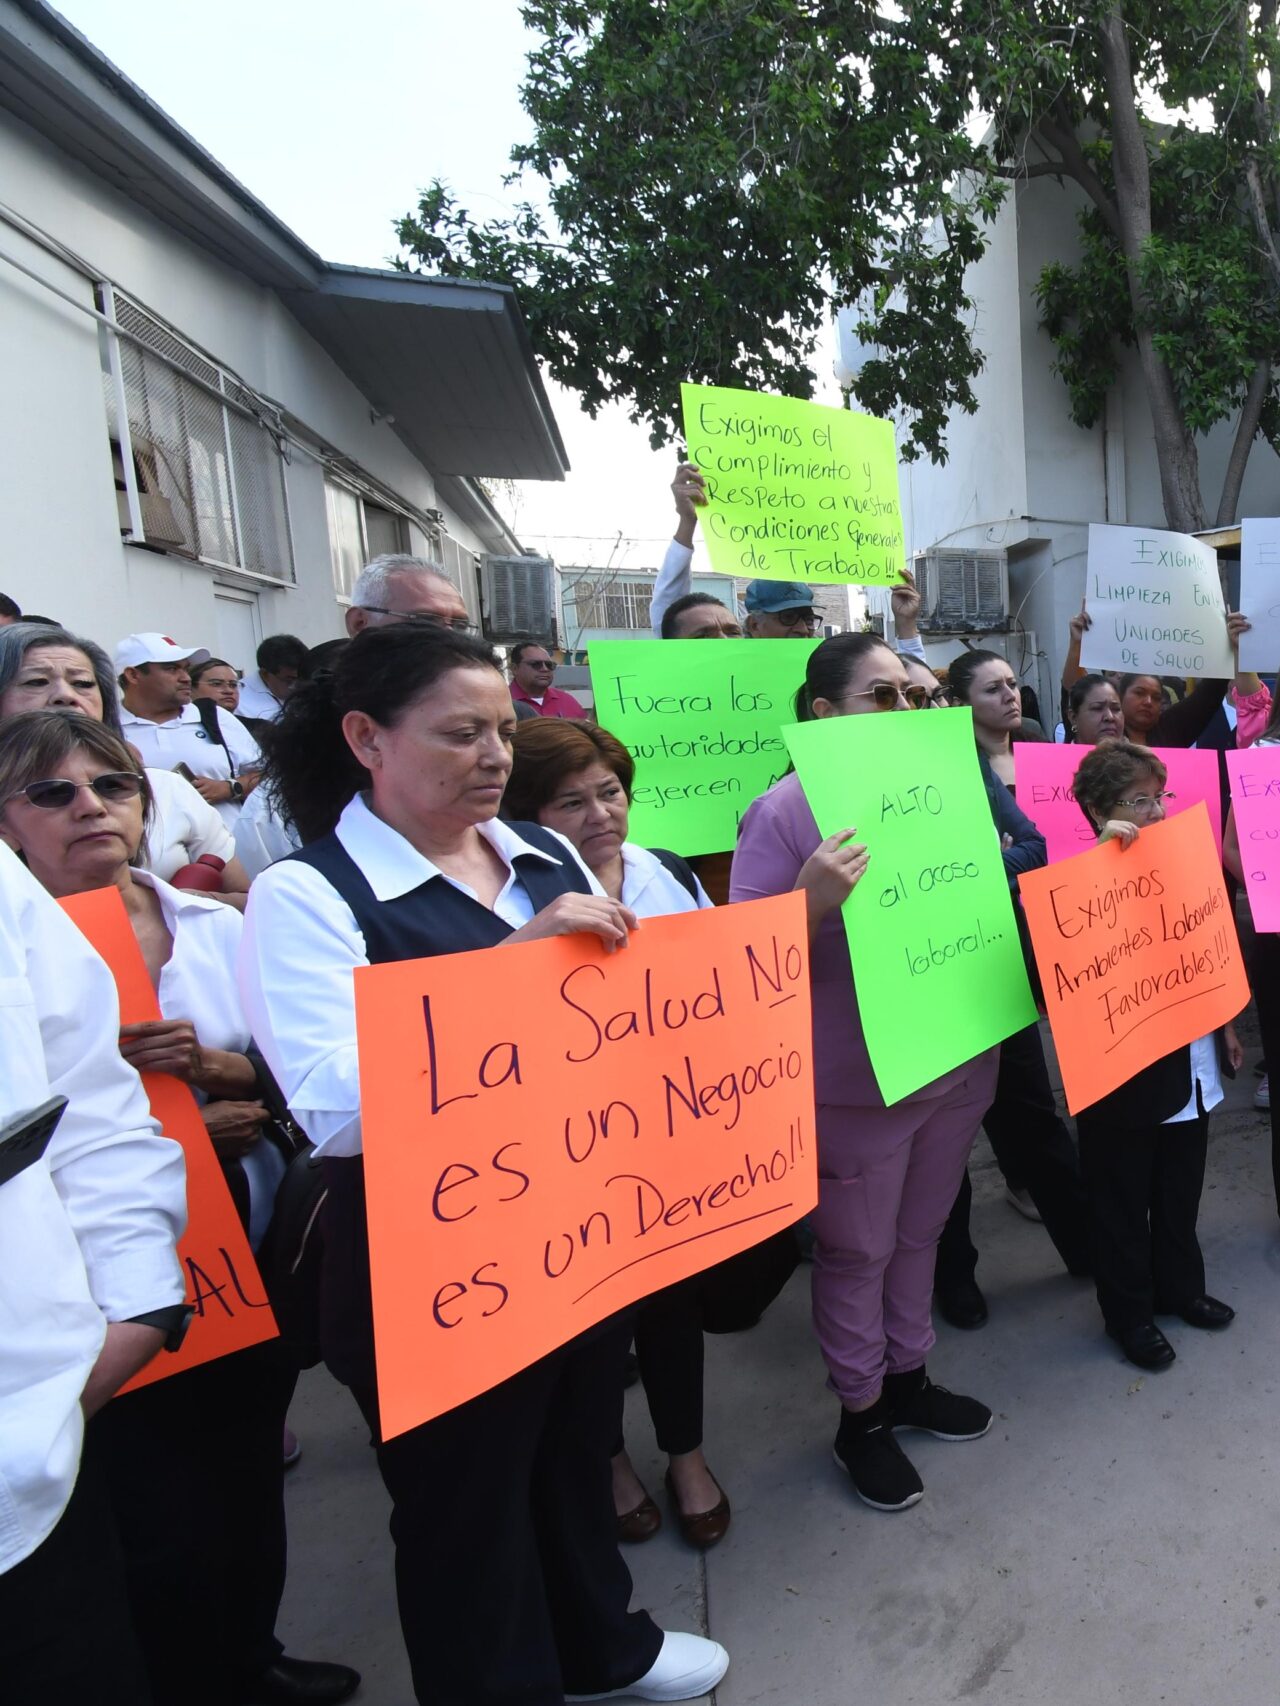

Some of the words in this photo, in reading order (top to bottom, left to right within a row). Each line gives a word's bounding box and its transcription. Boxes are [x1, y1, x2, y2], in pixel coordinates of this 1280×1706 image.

[699, 402, 802, 446] Exigimos
[813, 424, 833, 451] el
[694, 446, 851, 480] Cumplimiento
[862, 461, 872, 492] y
[818, 496, 837, 510] a
[843, 494, 899, 518] nuestras
[709, 512, 840, 543] Condiciones
[847, 519, 903, 550] Generales
[741, 544, 771, 570] de
[1095, 574, 1172, 606] LIMPIEZA
[1115, 617, 1204, 645] UNIDADES
[1121, 648, 1140, 667] DE
[609, 674, 712, 716] Fuera
[730, 674, 773, 714] las
[626, 730, 785, 759] autoridades
[630, 777, 741, 809] ejercen
[880, 784, 943, 823] ALTO
[878, 873, 909, 909] al
[917, 860, 981, 893] acoso
[1250, 871, 1267, 882] a
[1050, 869, 1165, 939] Exigimos
[1054, 926, 1153, 1002] Ambientes
[1160, 887, 1225, 942] Laborales
[421, 993, 523, 1116] La
[560, 963, 726, 1063] Salud
[431, 1141, 531, 1224] es
[563, 1100, 640, 1164] un
[661, 1042, 803, 1139] Negocio
[431, 1261, 510, 1330] es
[542, 1210, 612, 1280] un
